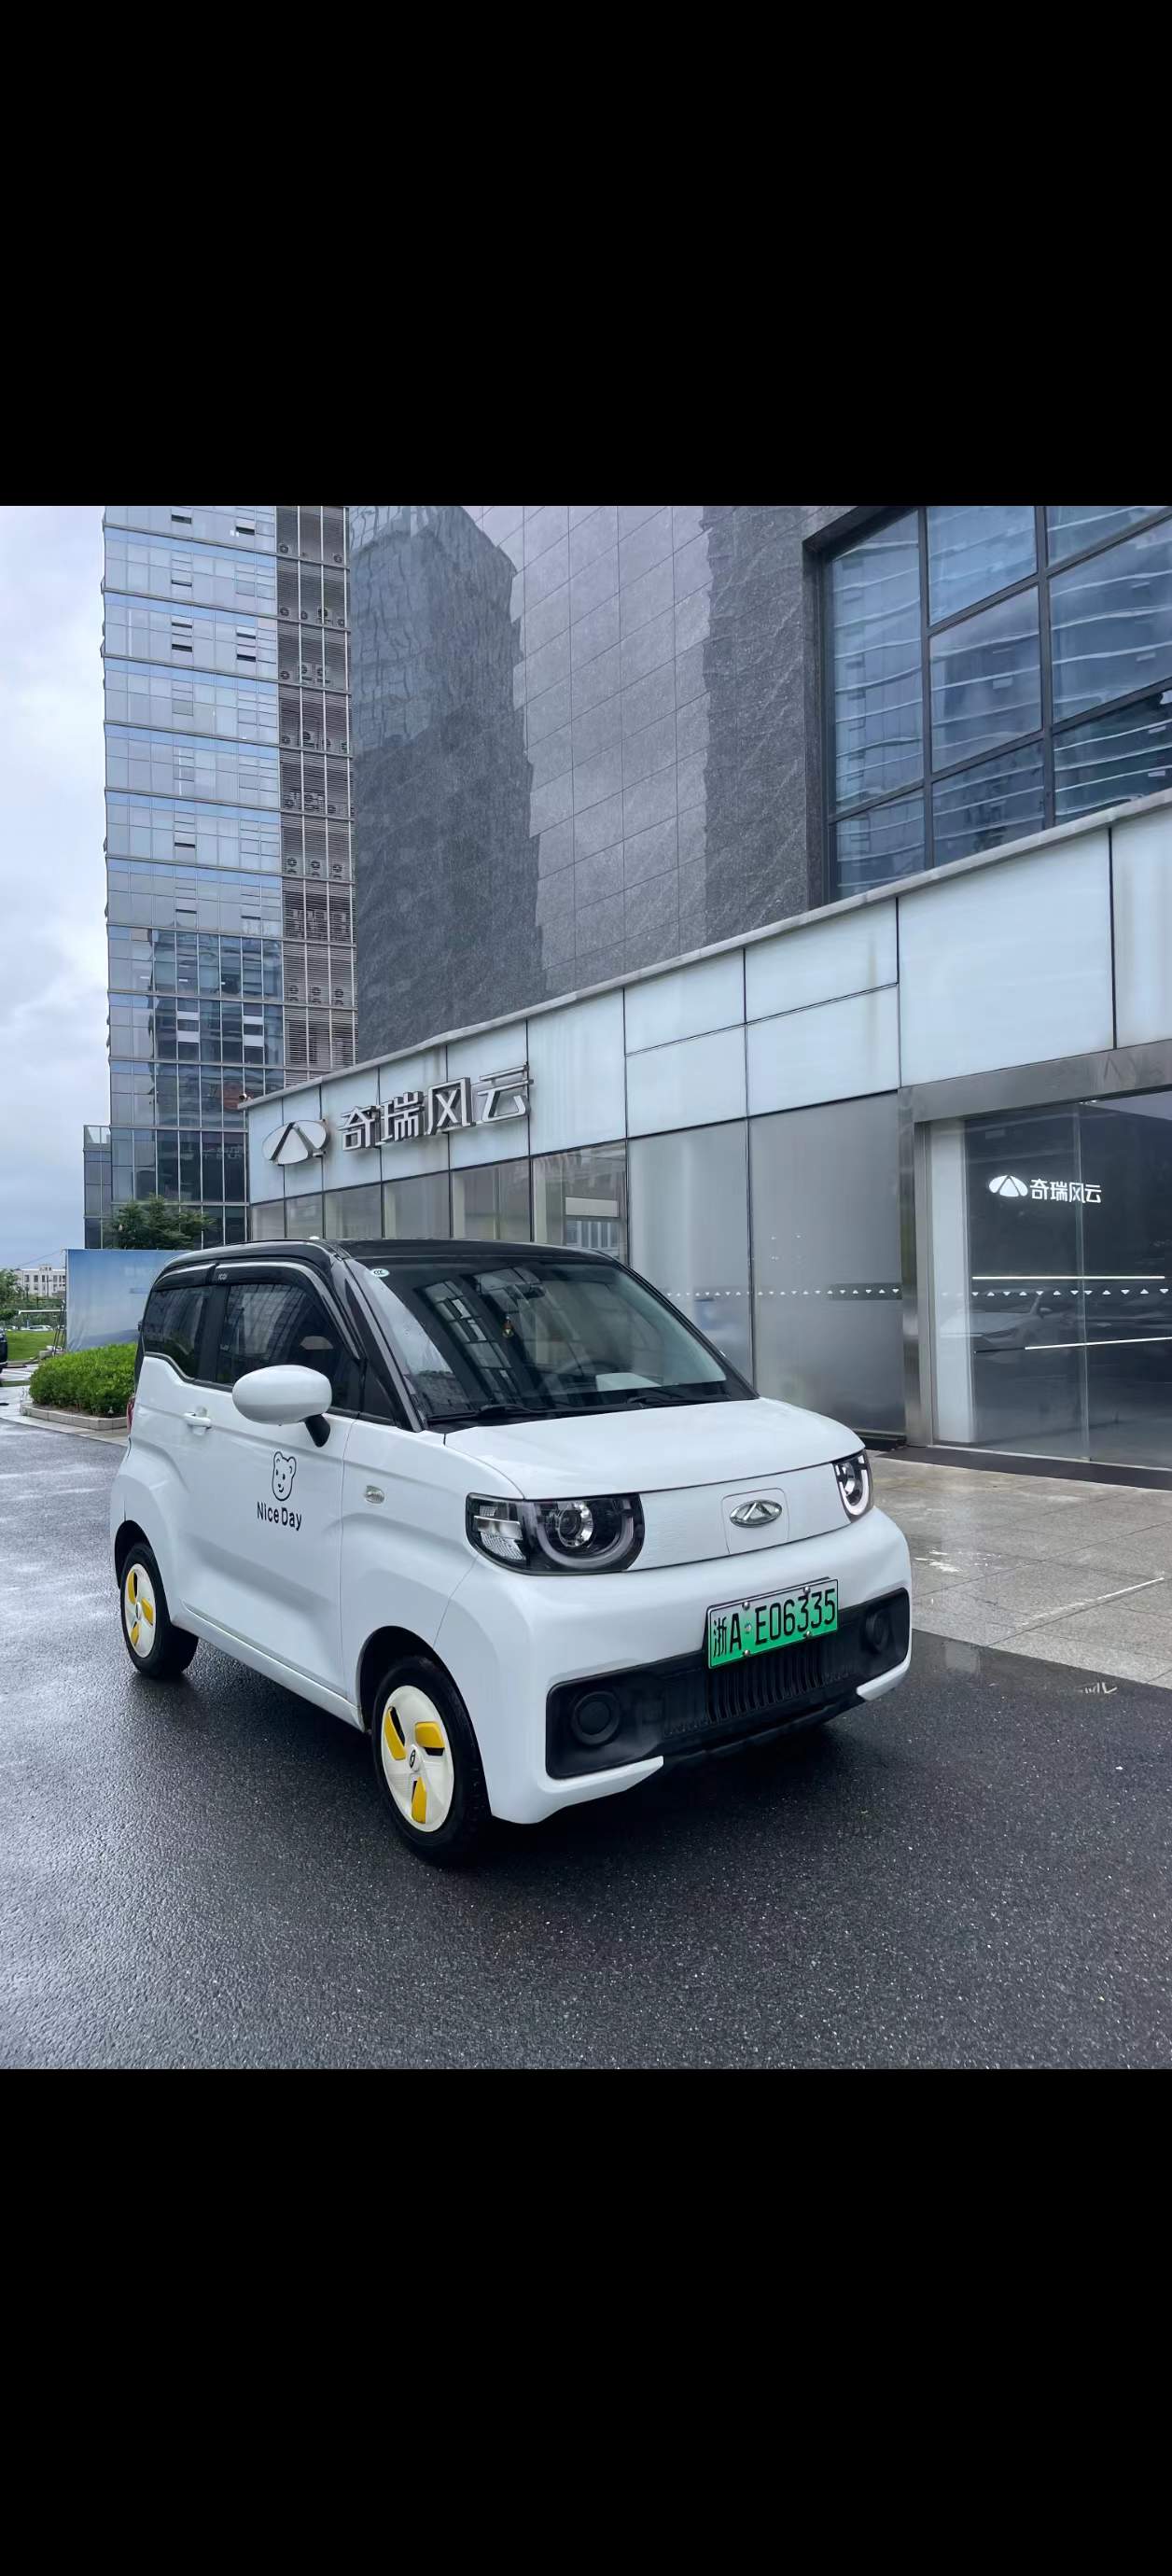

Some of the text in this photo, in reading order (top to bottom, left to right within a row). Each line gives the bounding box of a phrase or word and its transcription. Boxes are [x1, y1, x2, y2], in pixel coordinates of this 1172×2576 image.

[338, 1064, 533, 1151] 奇瑞风云
[1029, 1179, 1102, 1203] 奇瑞风云
[257, 1501, 302, 1532] Nice Day
